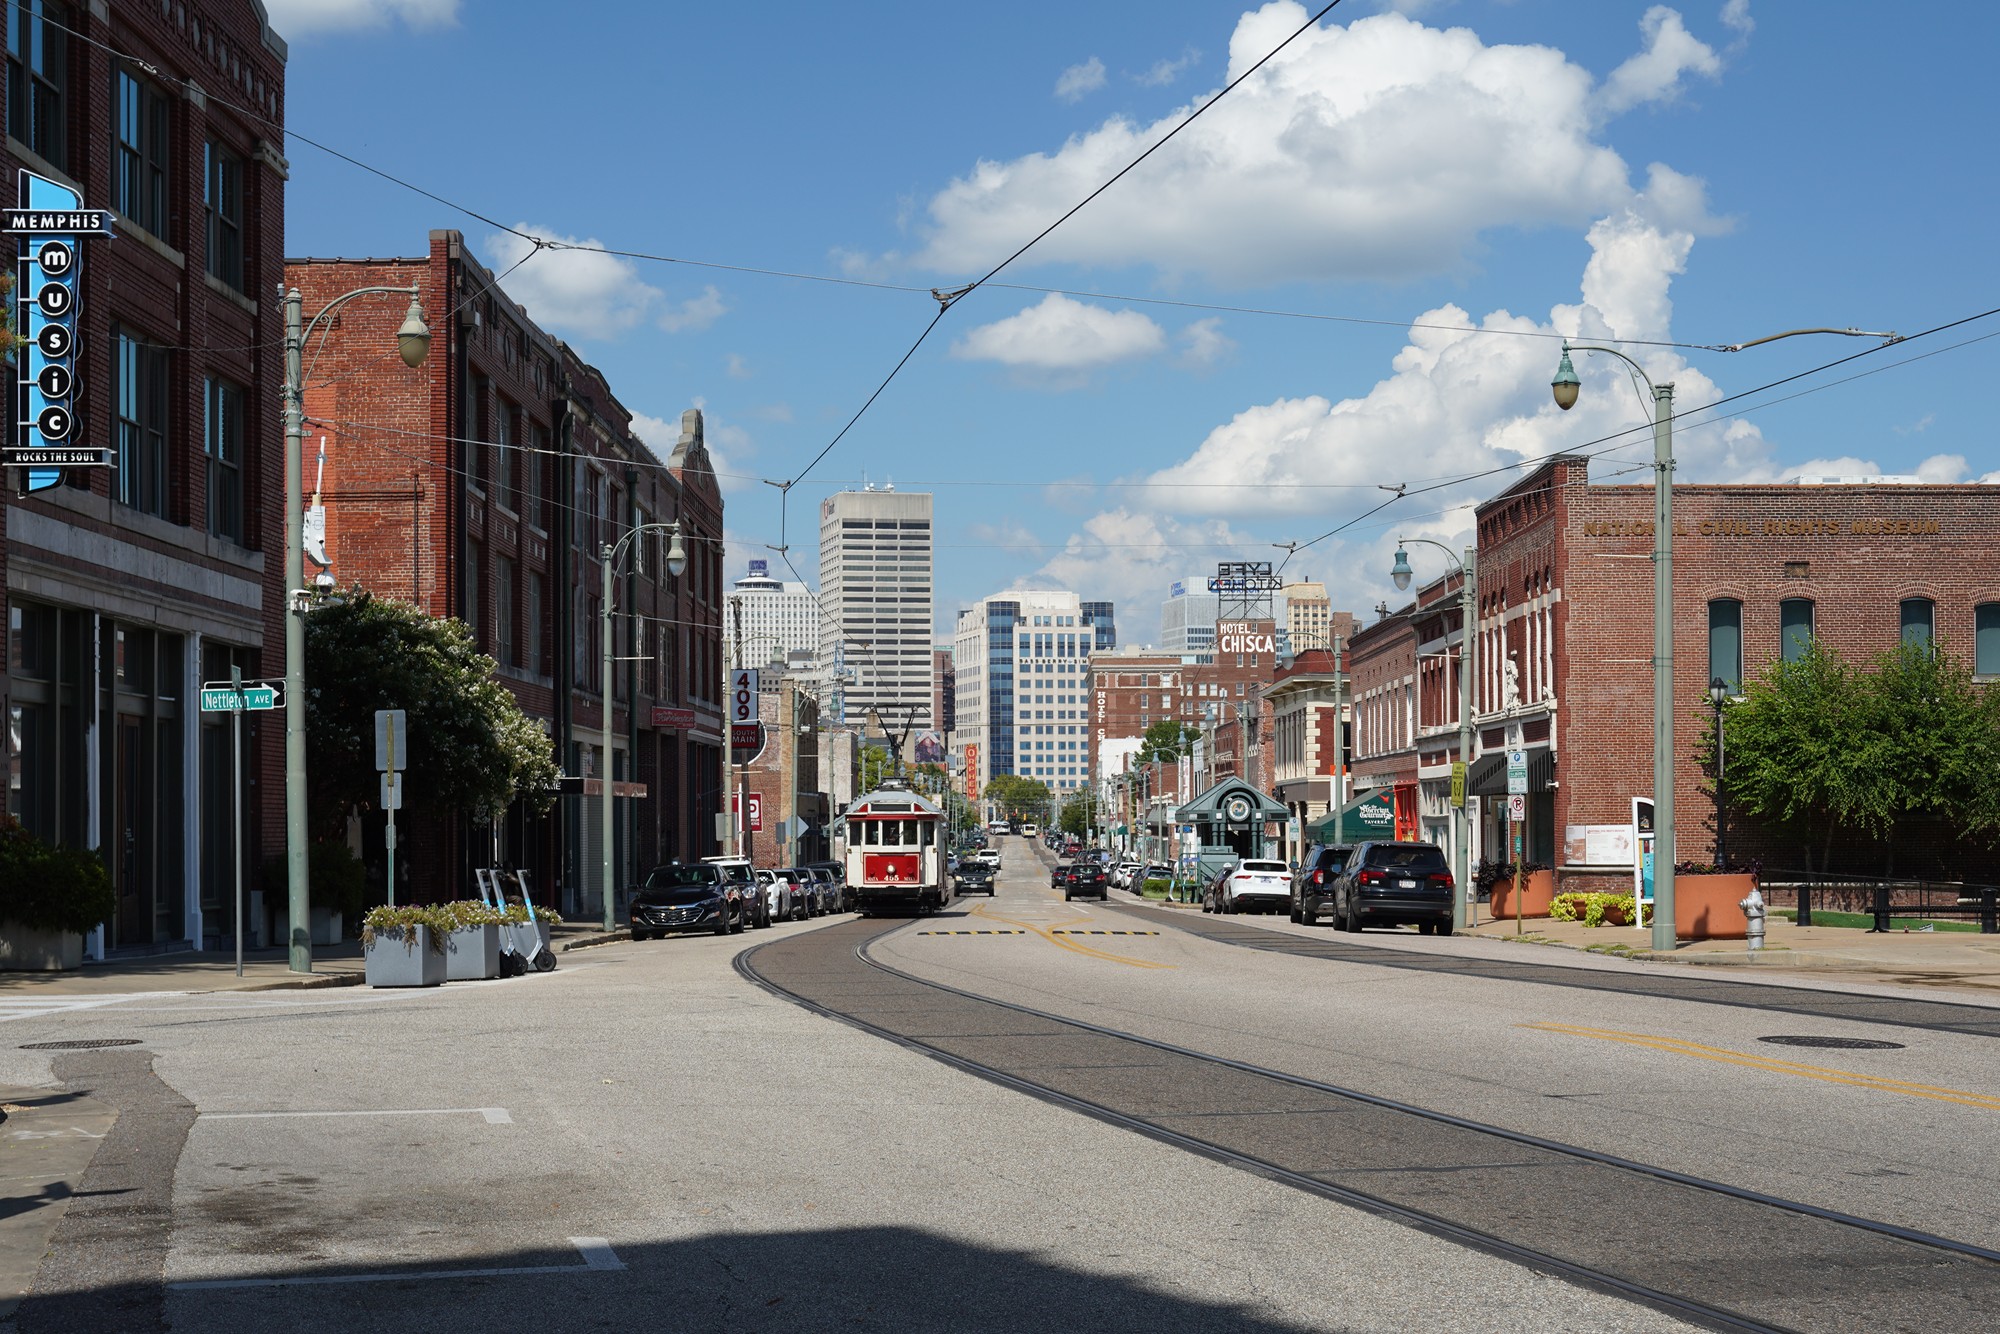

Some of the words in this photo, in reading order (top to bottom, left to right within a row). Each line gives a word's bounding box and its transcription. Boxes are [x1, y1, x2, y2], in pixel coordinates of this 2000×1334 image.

[12, 214, 100, 229] MEMPHIS
[16, 452, 47, 462] ROCKS
[50, 452, 67, 462] THE
[70, 452, 95, 462] SOUL
[1583, 521, 1688, 536] NATIONL
[1699, 520, 1753, 536] CIVIL
[1763, 519, 1840, 535] RIGHTS
[1850, 519, 1940, 535] MUSEUM
[1220, 623, 1251, 634] HOTEL
[1221, 635, 1275, 653] CHISCA
[205, 692, 250, 709] Nettleton
[254, 695, 270, 704] AVE
